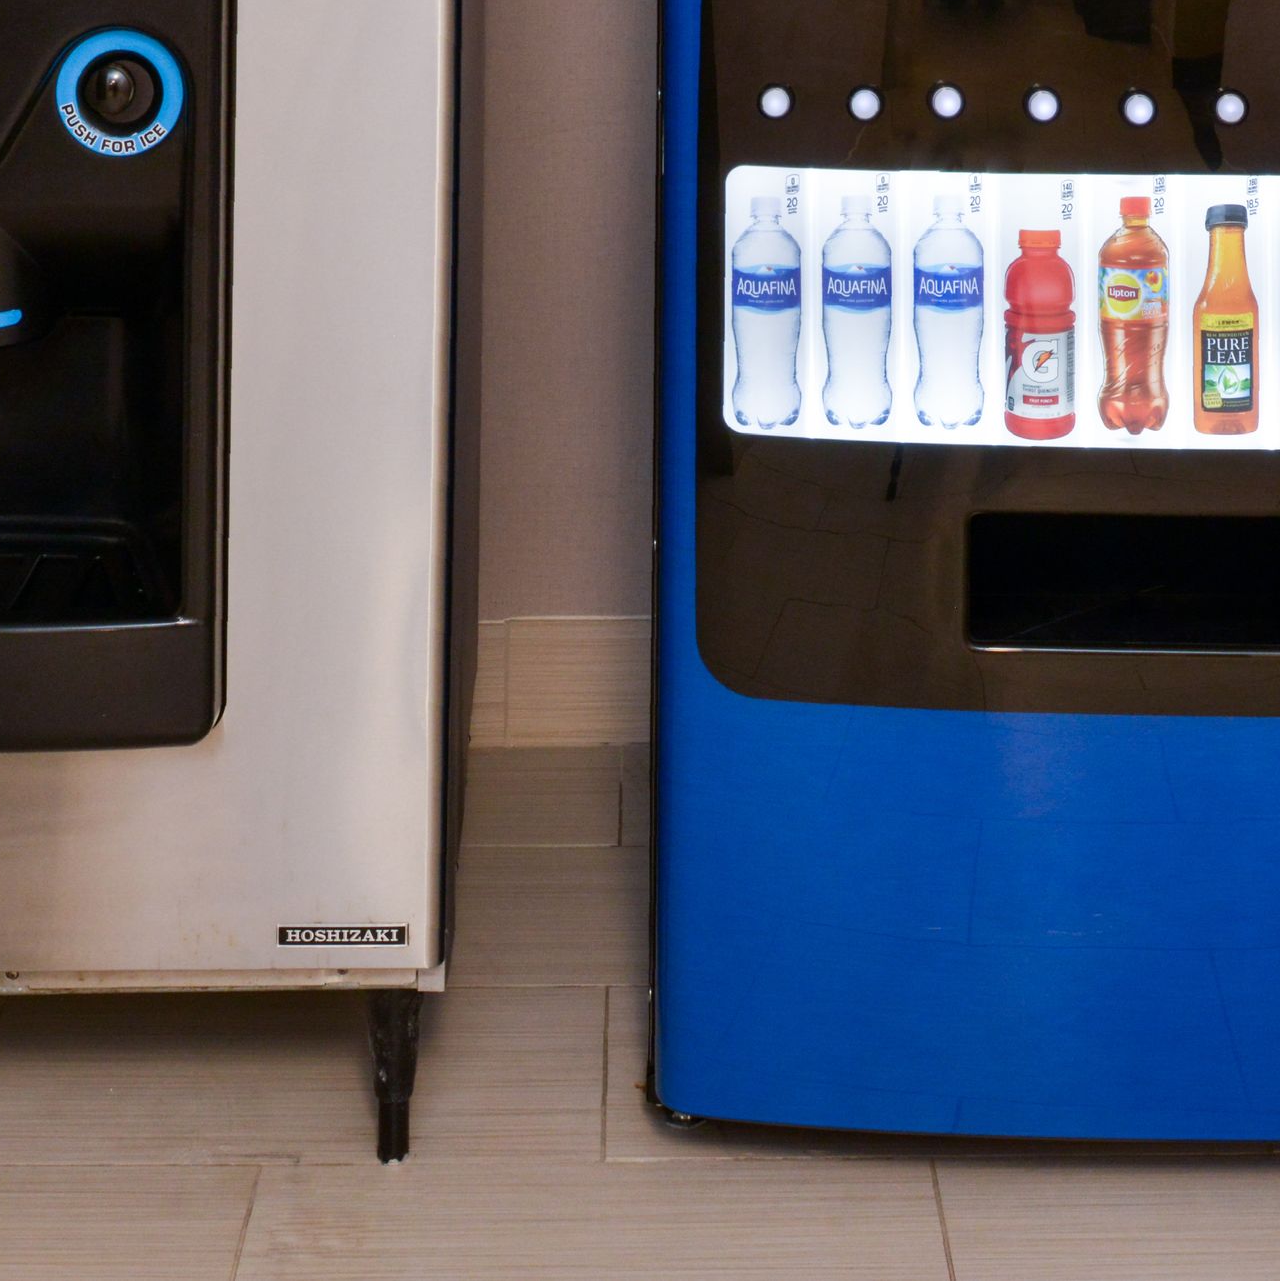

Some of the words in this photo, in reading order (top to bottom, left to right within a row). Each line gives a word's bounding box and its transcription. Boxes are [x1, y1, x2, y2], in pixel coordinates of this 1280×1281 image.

[61, 104, 97, 145] PUSH
[101, 139, 135, 152] FOR
[139, 123, 166, 147] ICE
[786, 197, 798, 208] 20
[877, 195, 888, 206] 20
[970, 195, 981, 206] 20
[1154, 197, 1164, 207] 20
[1061, 203, 1073, 213] 20
[736, 277, 797, 298] AQUAFINA
[827, 276, 887, 297] AQUAFINA
[919, 276, 979, 297] AQUAFINA
[1110, 288, 1136, 298] Lipton
[1207, 337, 1249, 351] PURE
[286, 929, 399, 942] HOSHIZAKI
